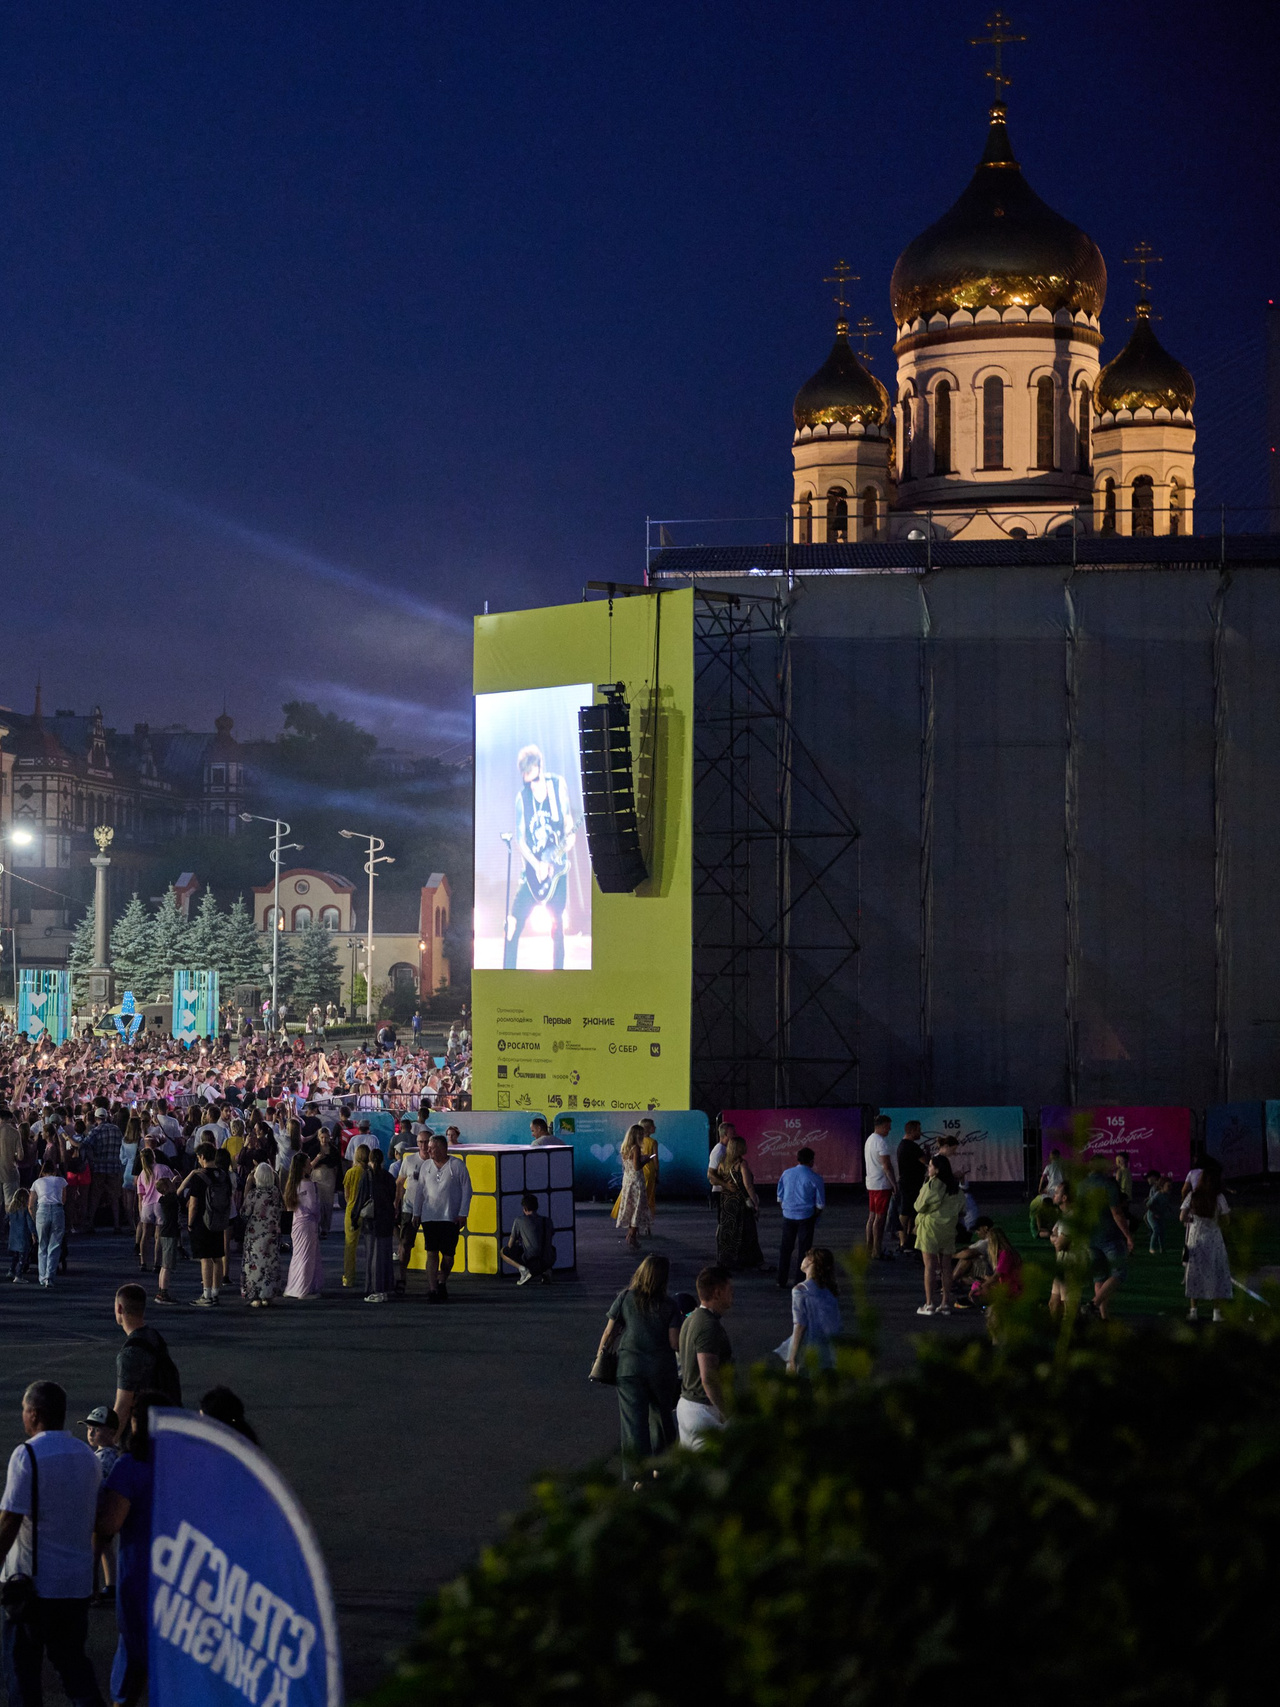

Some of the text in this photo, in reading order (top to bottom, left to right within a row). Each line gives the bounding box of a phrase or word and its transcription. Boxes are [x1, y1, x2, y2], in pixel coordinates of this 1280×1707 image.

[543, 1015, 572, 1027] Первые
[507, 1042, 540, 1050] РОСАТОМ
[618, 1045, 638, 1053] СБЕР
[611, 1100, 641, 1110] GloraX
[784, 1119, 801, 1128] 165
[942, 1120, 961, 1129] 165
[1106, 1116, 1125, 1126] 165
